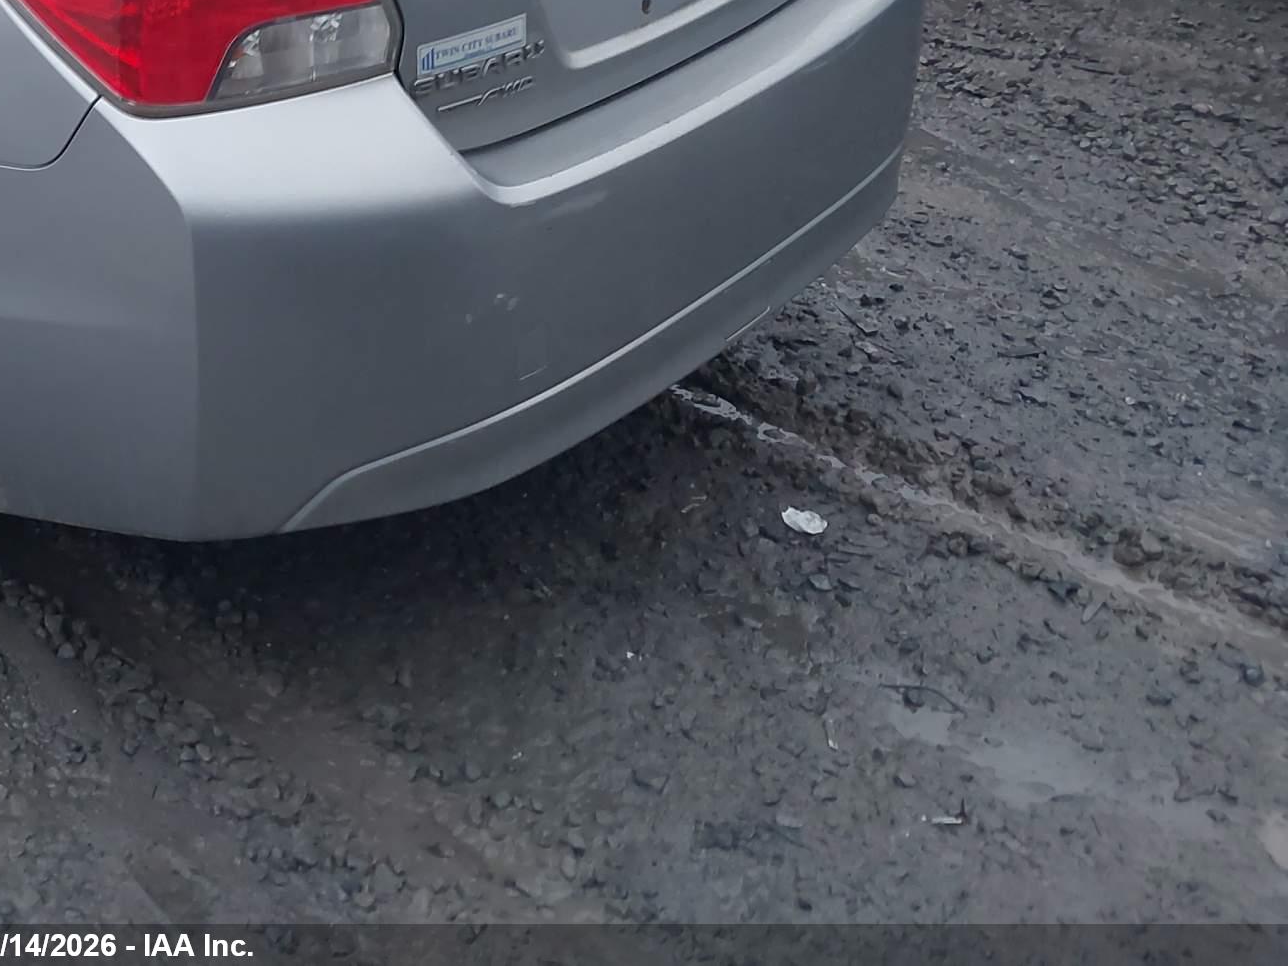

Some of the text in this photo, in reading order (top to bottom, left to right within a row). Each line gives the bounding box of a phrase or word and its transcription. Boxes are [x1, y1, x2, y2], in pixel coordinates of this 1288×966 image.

[413, 39, 545, 95] SUBARU
[435, 46, 460, 61] TWIN
[462, 37, 483, 53] CITY
